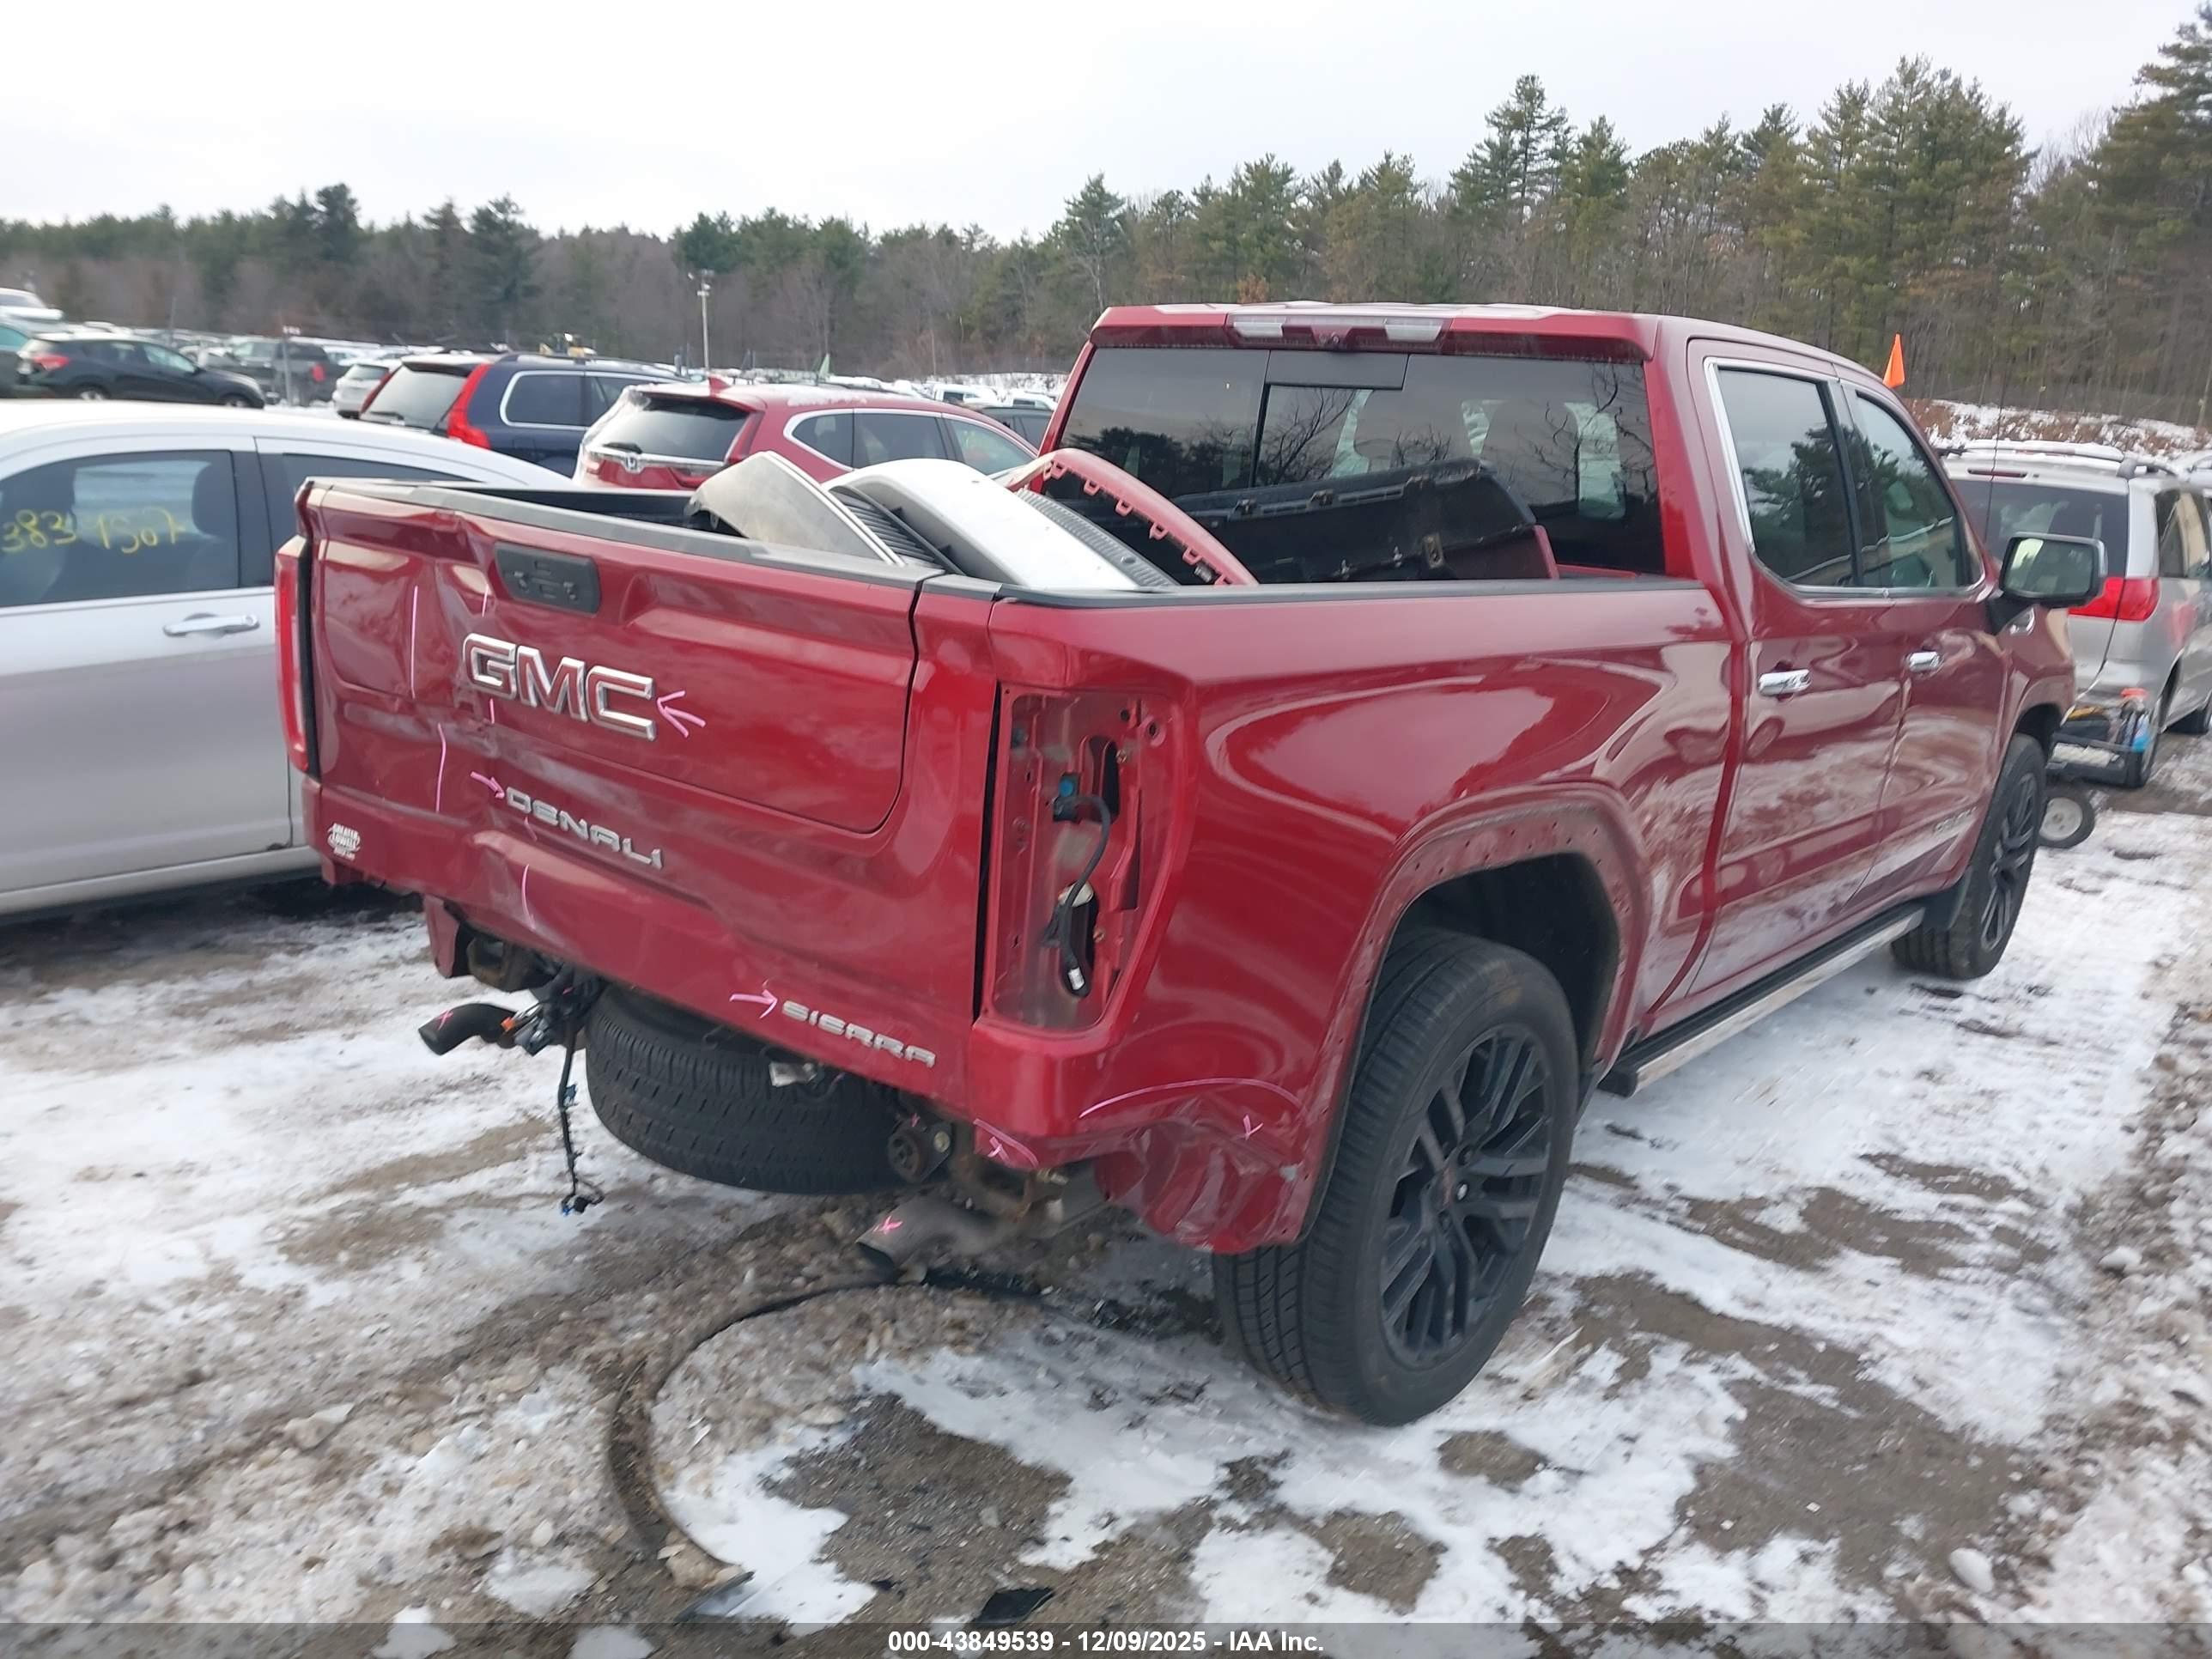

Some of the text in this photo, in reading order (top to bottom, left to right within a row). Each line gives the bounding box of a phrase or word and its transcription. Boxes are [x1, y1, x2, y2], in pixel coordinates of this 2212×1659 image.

[462, 633, 656, 742] GMC
[506, 787, 664, 870] DENALI
[781, 1000, 936, 1068] SIERRA
